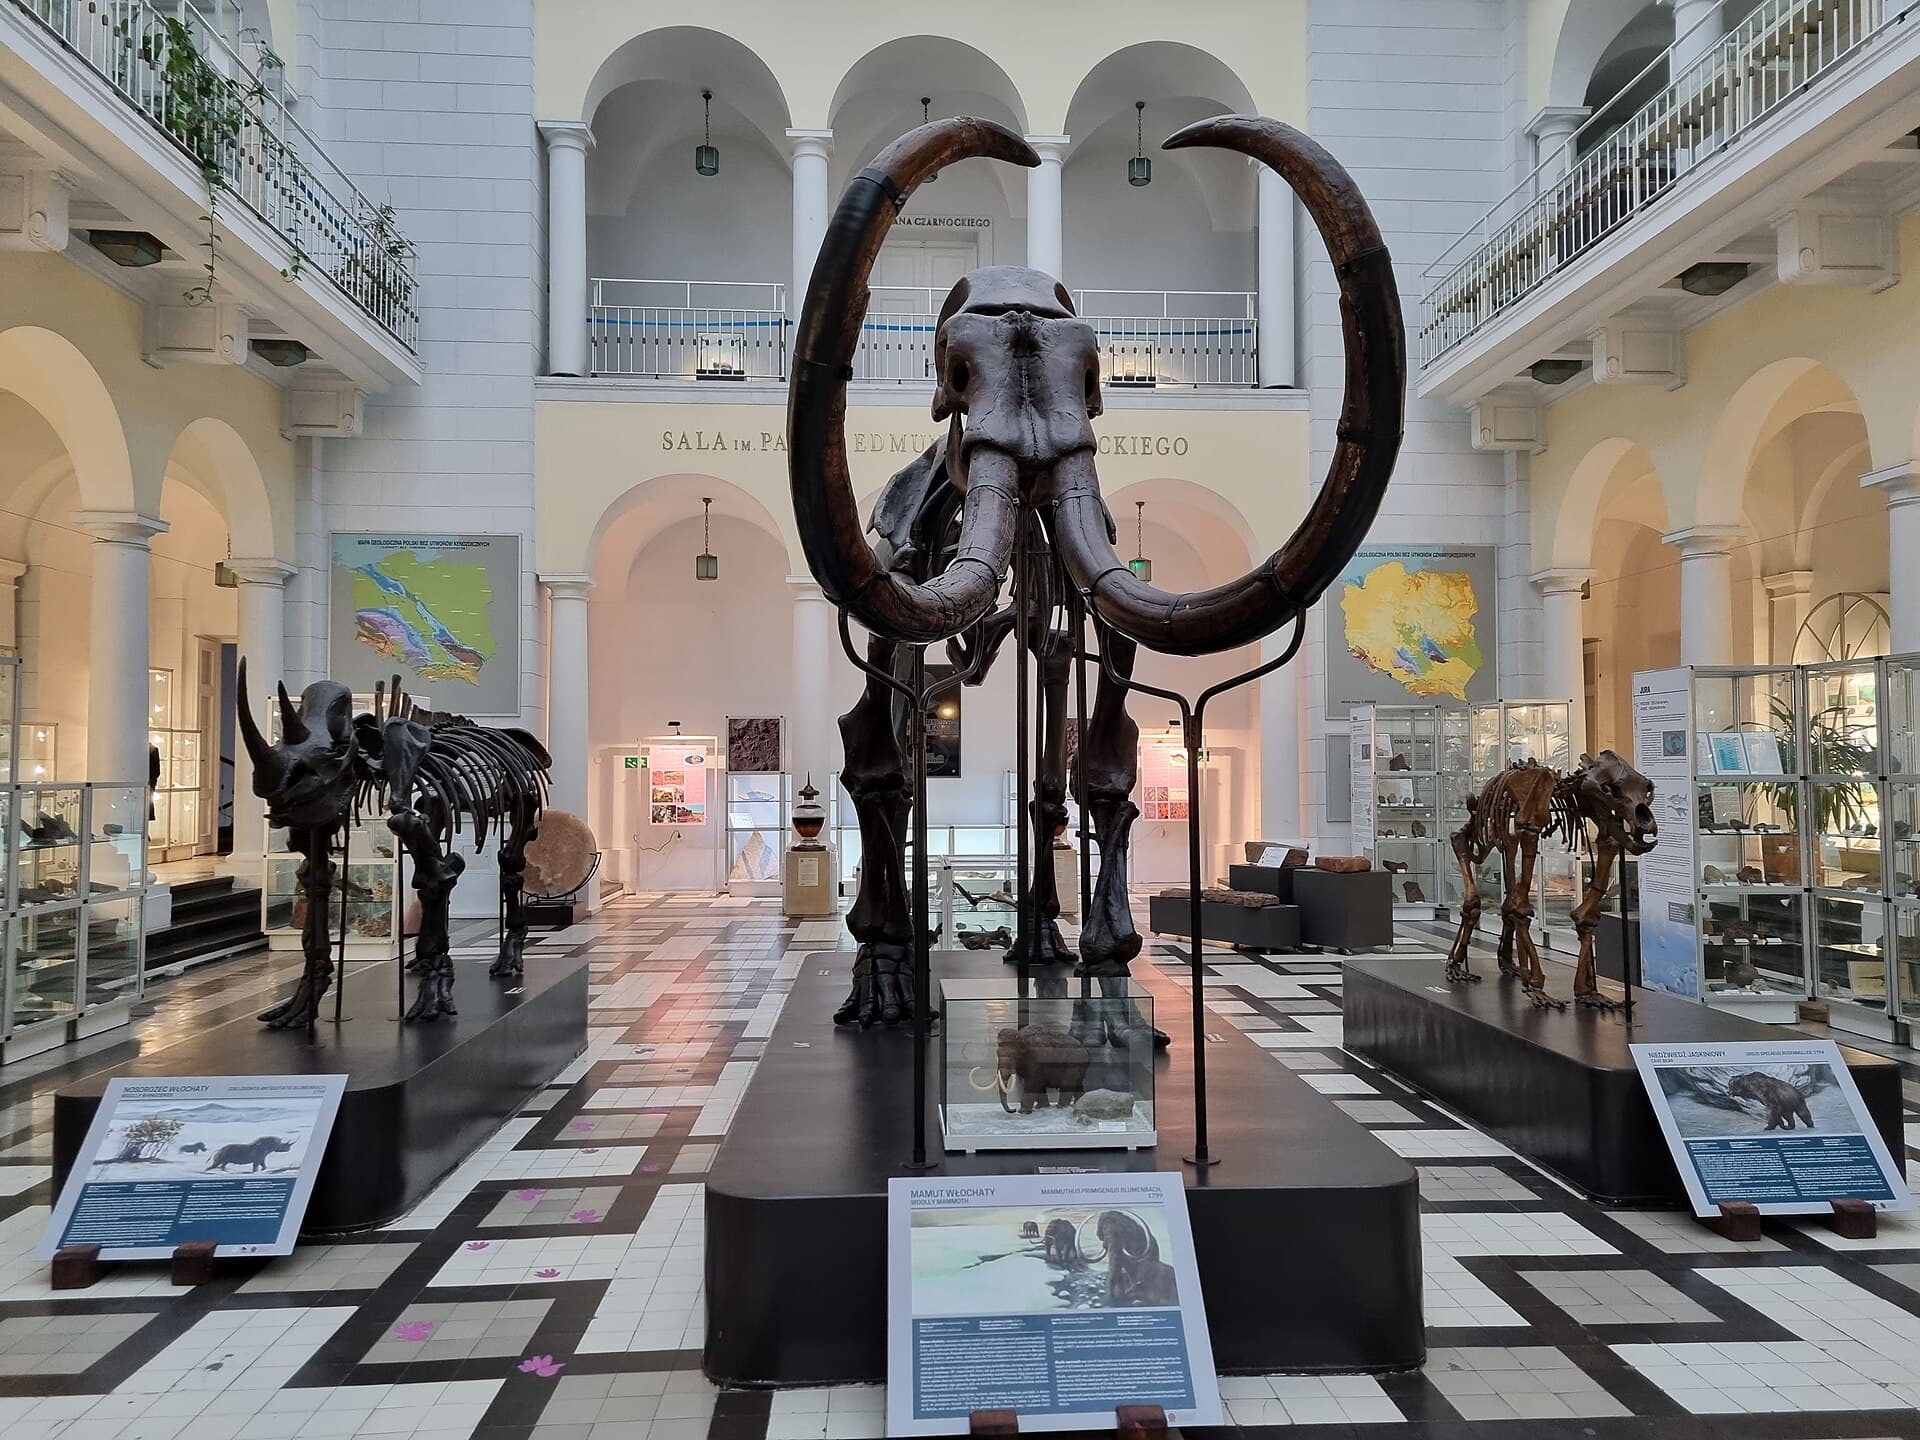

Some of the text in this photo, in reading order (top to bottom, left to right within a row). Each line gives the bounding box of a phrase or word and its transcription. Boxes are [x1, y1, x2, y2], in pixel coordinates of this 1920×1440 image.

[893, 216, 991, 227] ANA CZARNOCKIEGO
[662, 431, 727, 450] SALA
[760, 432, 788, 451] PA
[854, 433, 935, 453] EDMU
[1098, 435, 1189, 456] CKIEGO
[910, 1186, 996, 1199] MAMUT WŁOCHATY
